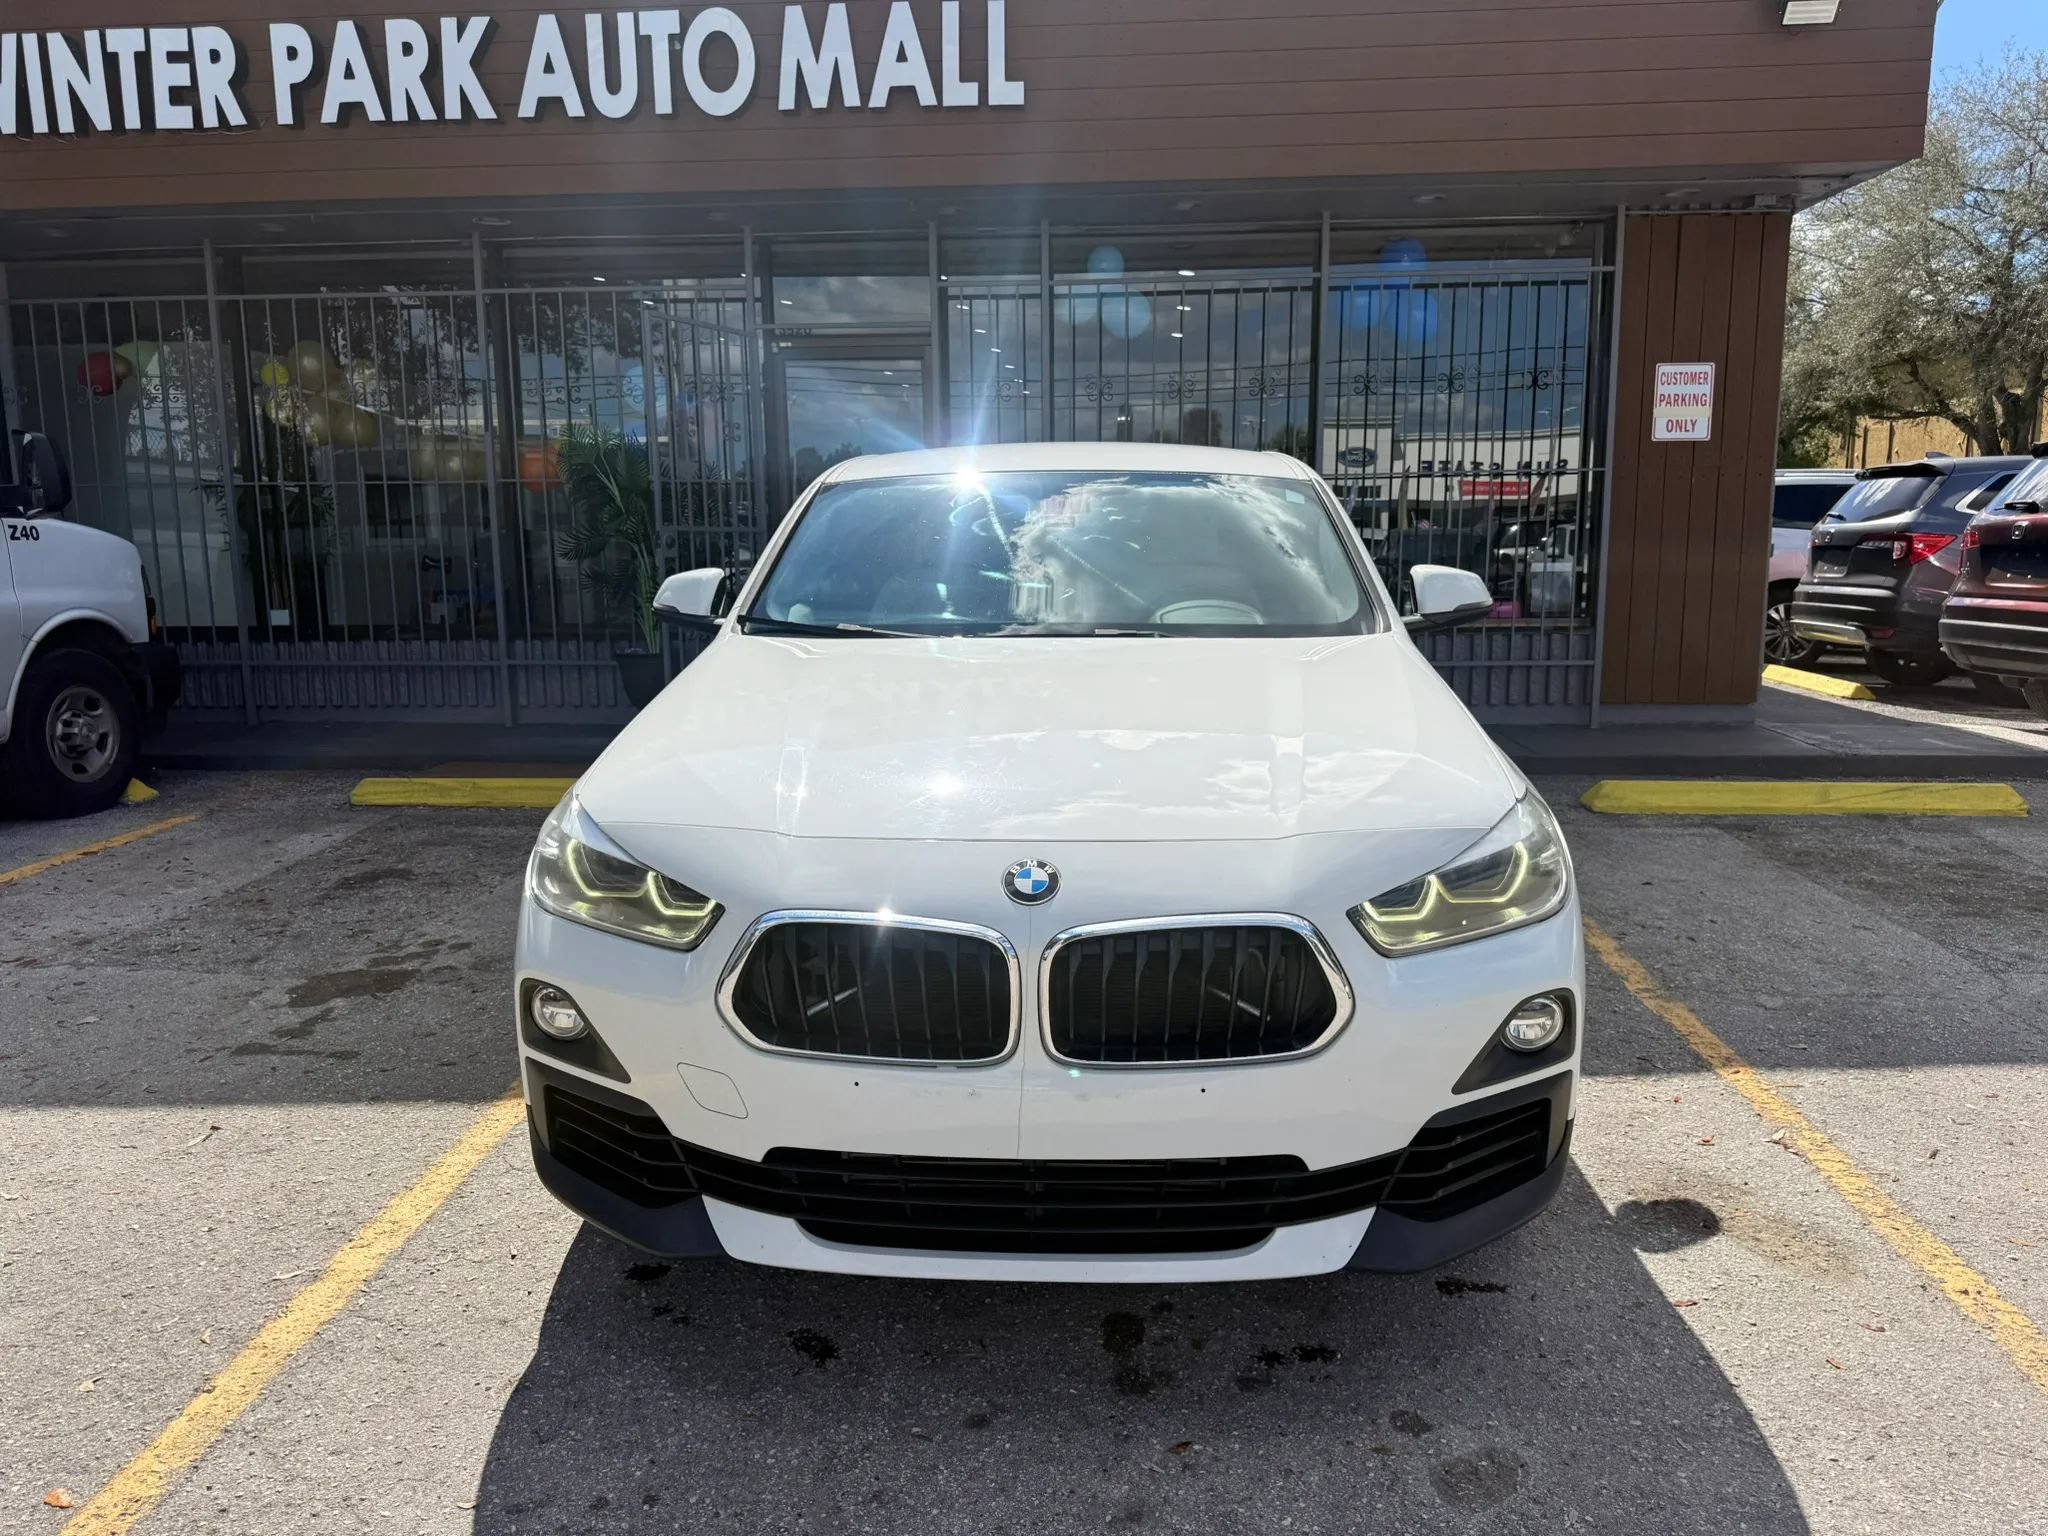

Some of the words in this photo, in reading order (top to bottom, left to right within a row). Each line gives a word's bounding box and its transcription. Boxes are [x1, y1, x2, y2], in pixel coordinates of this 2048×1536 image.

[0, 26, 248, 135] INTER
[269, 16, 498, 126] PARK
[517, 6, 756, 119] AUTO
[778, 0, 1025, 110] MALL
[1660, 371, 1709, 386] CUSTOMER
[1659, 393, 1708, 407] PARKING
[1666, 418, 1698, 433] ONLY
[8, 525, 39, 541] Z40
[1010, 859, 1056, 874] BMW
